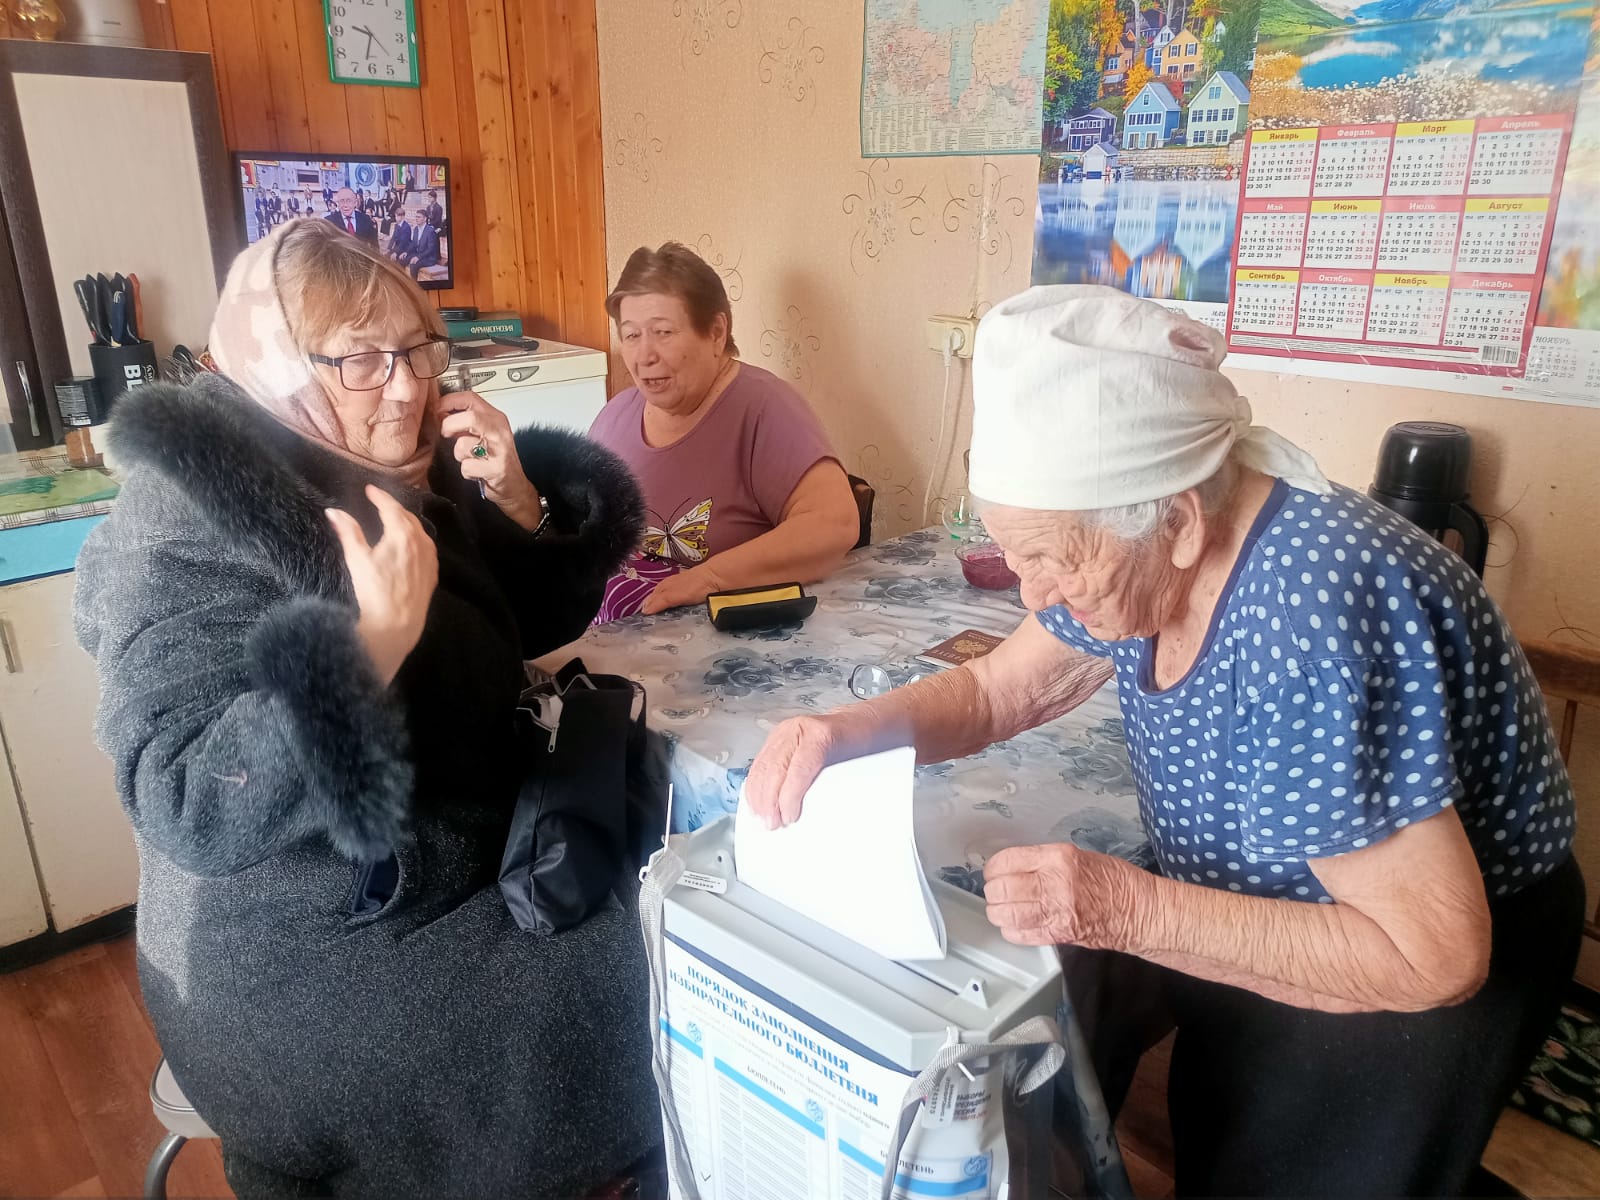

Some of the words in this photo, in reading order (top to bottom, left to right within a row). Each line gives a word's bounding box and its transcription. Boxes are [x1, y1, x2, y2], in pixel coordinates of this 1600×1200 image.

[333, 6, 346, 17] 10
[394, 9, 403, 21] 2
[334, 25, 344, 37] 9
[395, 32, 404, 43] 3
[336, 47, 346, 59] 8
[397, 53, 405, 64] 4
[351, 61, 359, 73] 7
[367, 63, 377, 74] 6
[386, 64, 395, 76] 5
[1422, 125, 1446, 134] Март
[1488, 202, 1524, 211] Август
[1249, 272, 1285, 280] Сентябрь
[1318, 275, 1353, 283] Октябрь
[1394, 277, 1428, 286] Ноябрь
[1472, 279, 1514, 289] Декабрь
[688, 965, 748, 1010] ПОРЯДОК
[752, 1004, 849, 1073] ЗАПОЛНЕНИЯ
[669, 968, 782, 1047] ИЗБИРАТЕЛЬНОГО
[786, 1042, 878, 1106] БЮЛЛЕТЕНЯ
